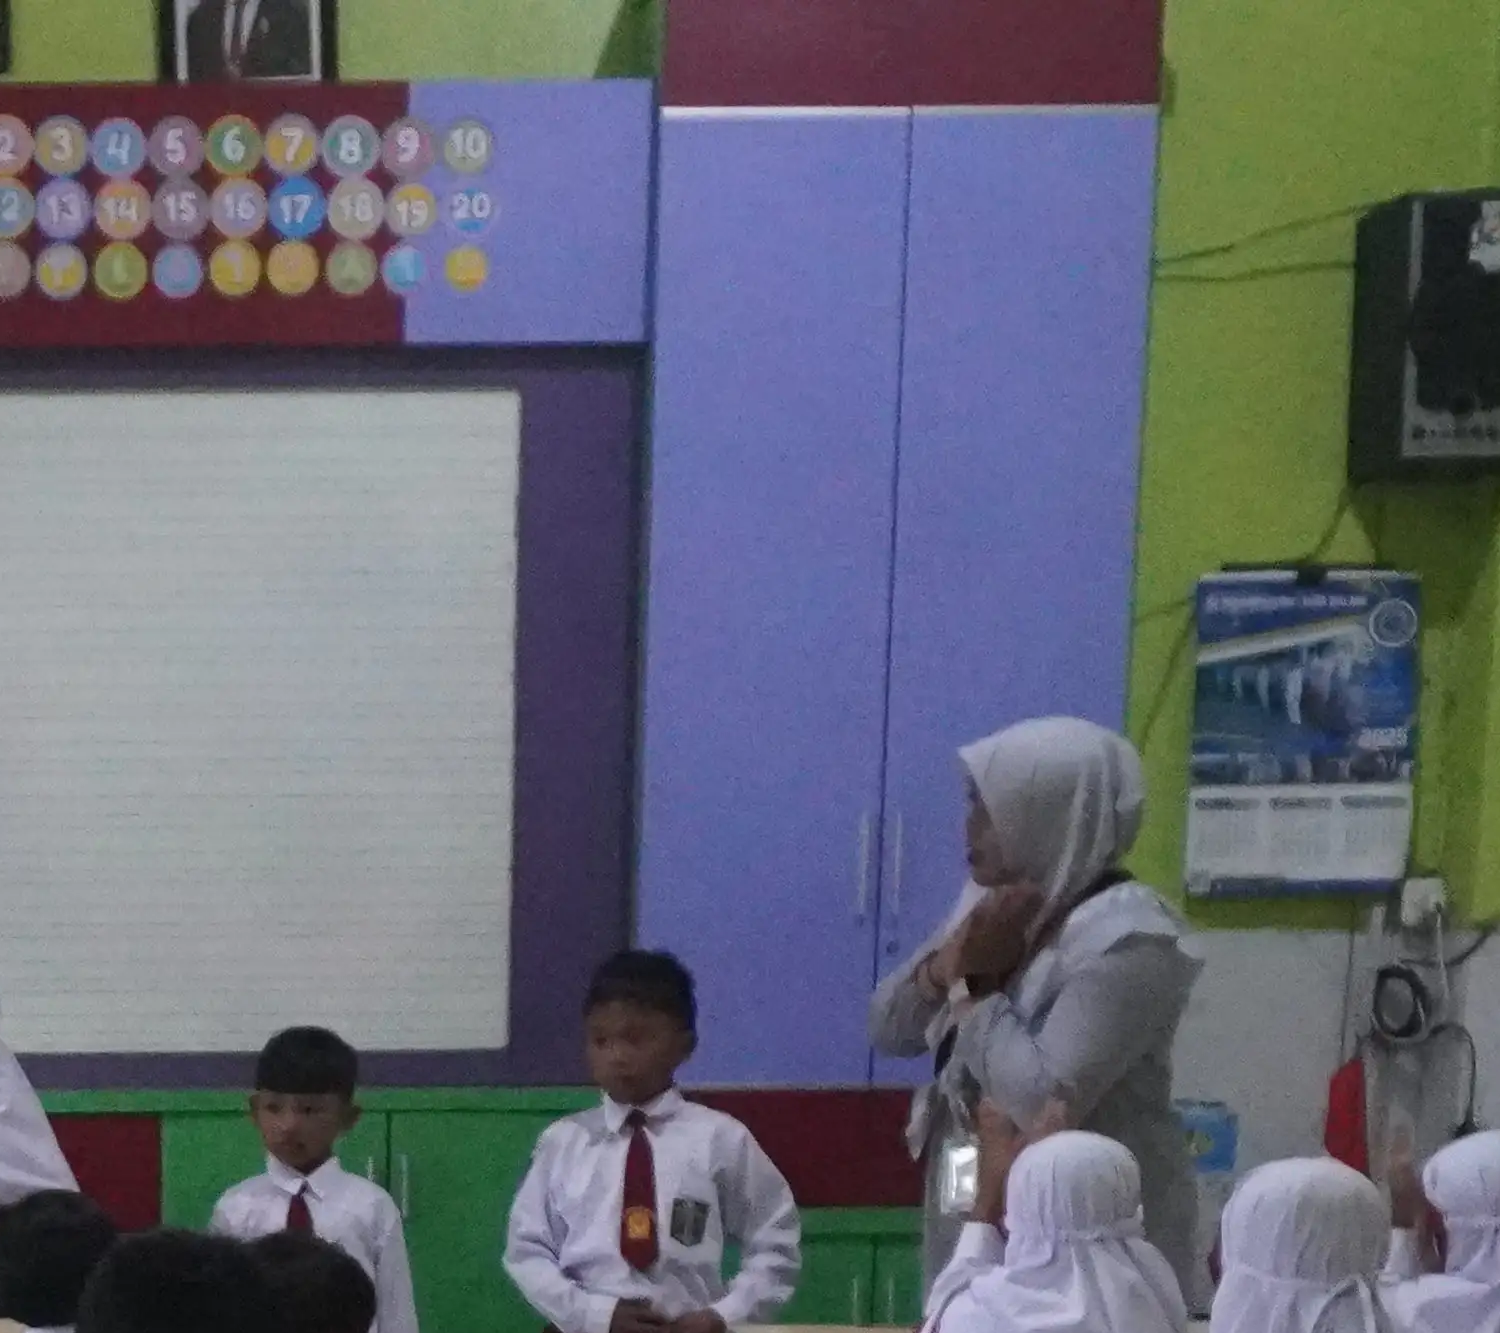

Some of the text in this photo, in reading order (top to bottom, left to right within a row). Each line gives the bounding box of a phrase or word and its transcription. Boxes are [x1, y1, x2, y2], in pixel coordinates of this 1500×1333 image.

[51, 127, 73, 162] 3
[107, 131, 131, 165] 4
[165, 128, 187, 164] 5
[222, 126, 246, 163] 6
[280, 127, 305, 162] 7
[338, 128, 362, 164] 8
[396, 127, 420, 162] 9
[450, 127, 487, 159] 10
[48, 193, 79, 224] 13
[103, 197, 138, 222] 14
[163, 192, 197, 222] 15
[224, 193, 256, 220] 16
[279, 194, 313, 224] 17
[338, 192, 374, 222] 18
[396, 200, 429, 227] 19
[452, 192, 492, 218] 20
